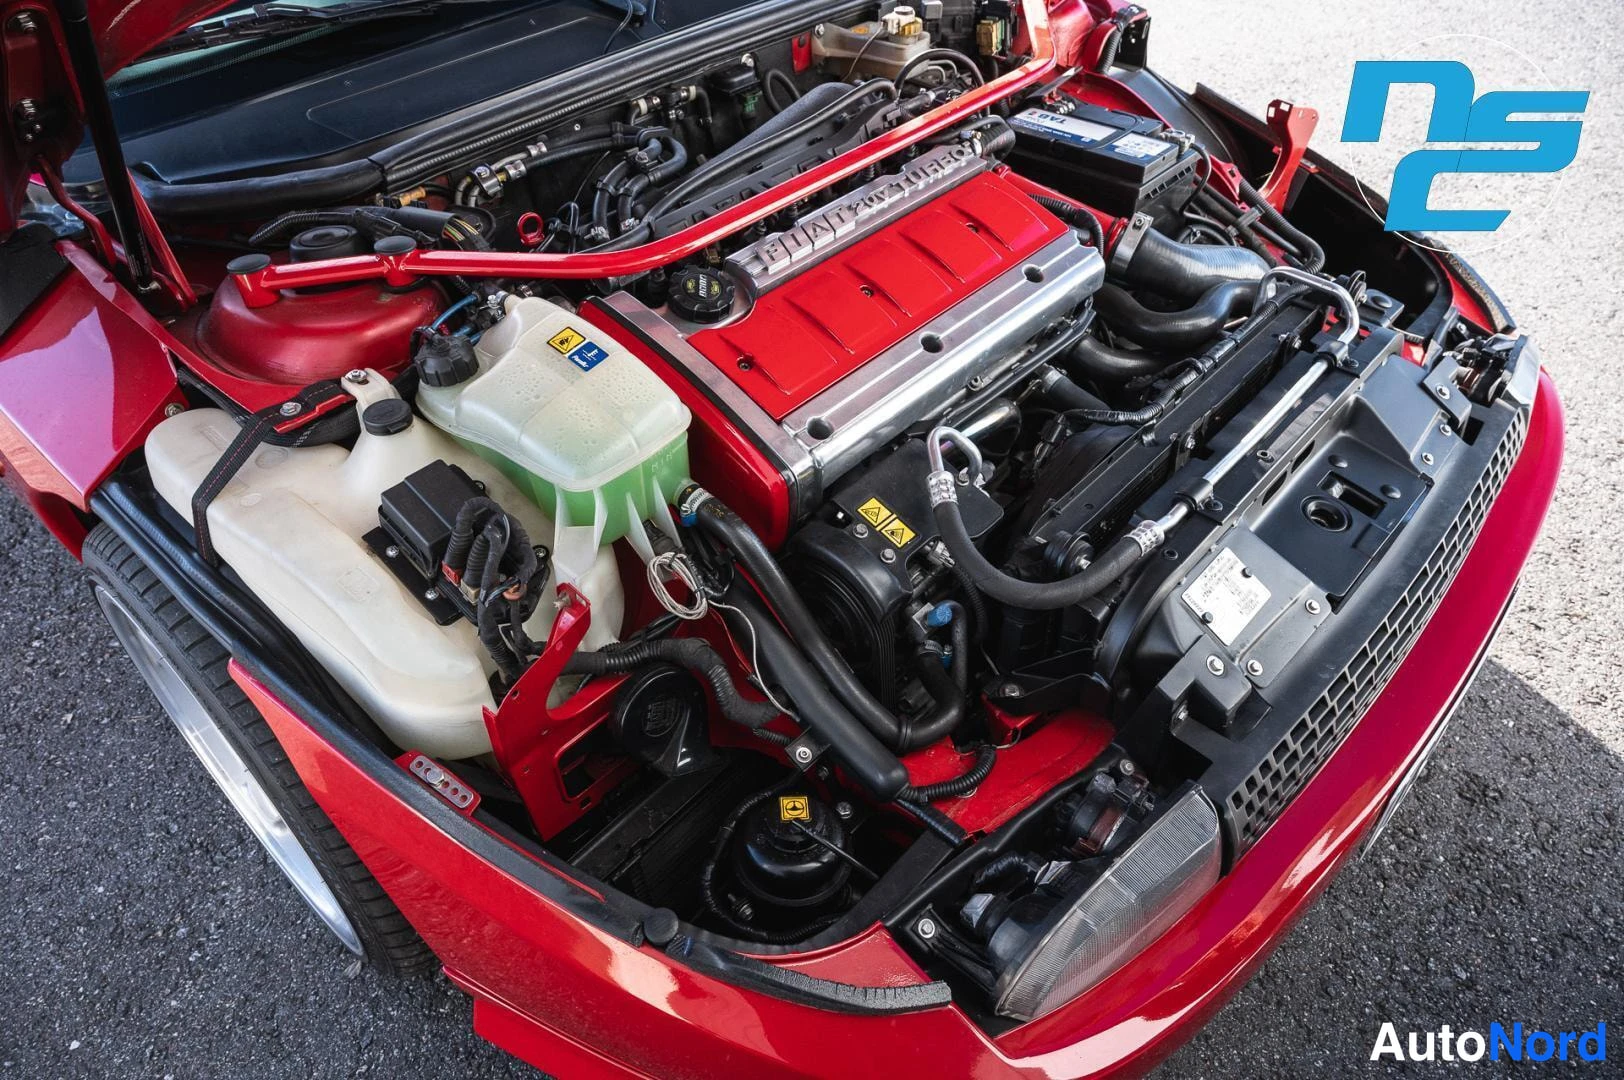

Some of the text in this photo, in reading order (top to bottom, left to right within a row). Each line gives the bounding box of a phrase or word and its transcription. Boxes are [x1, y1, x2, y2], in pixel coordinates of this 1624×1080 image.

[759, 148, 967, 265] FIAT 20V TURBO
